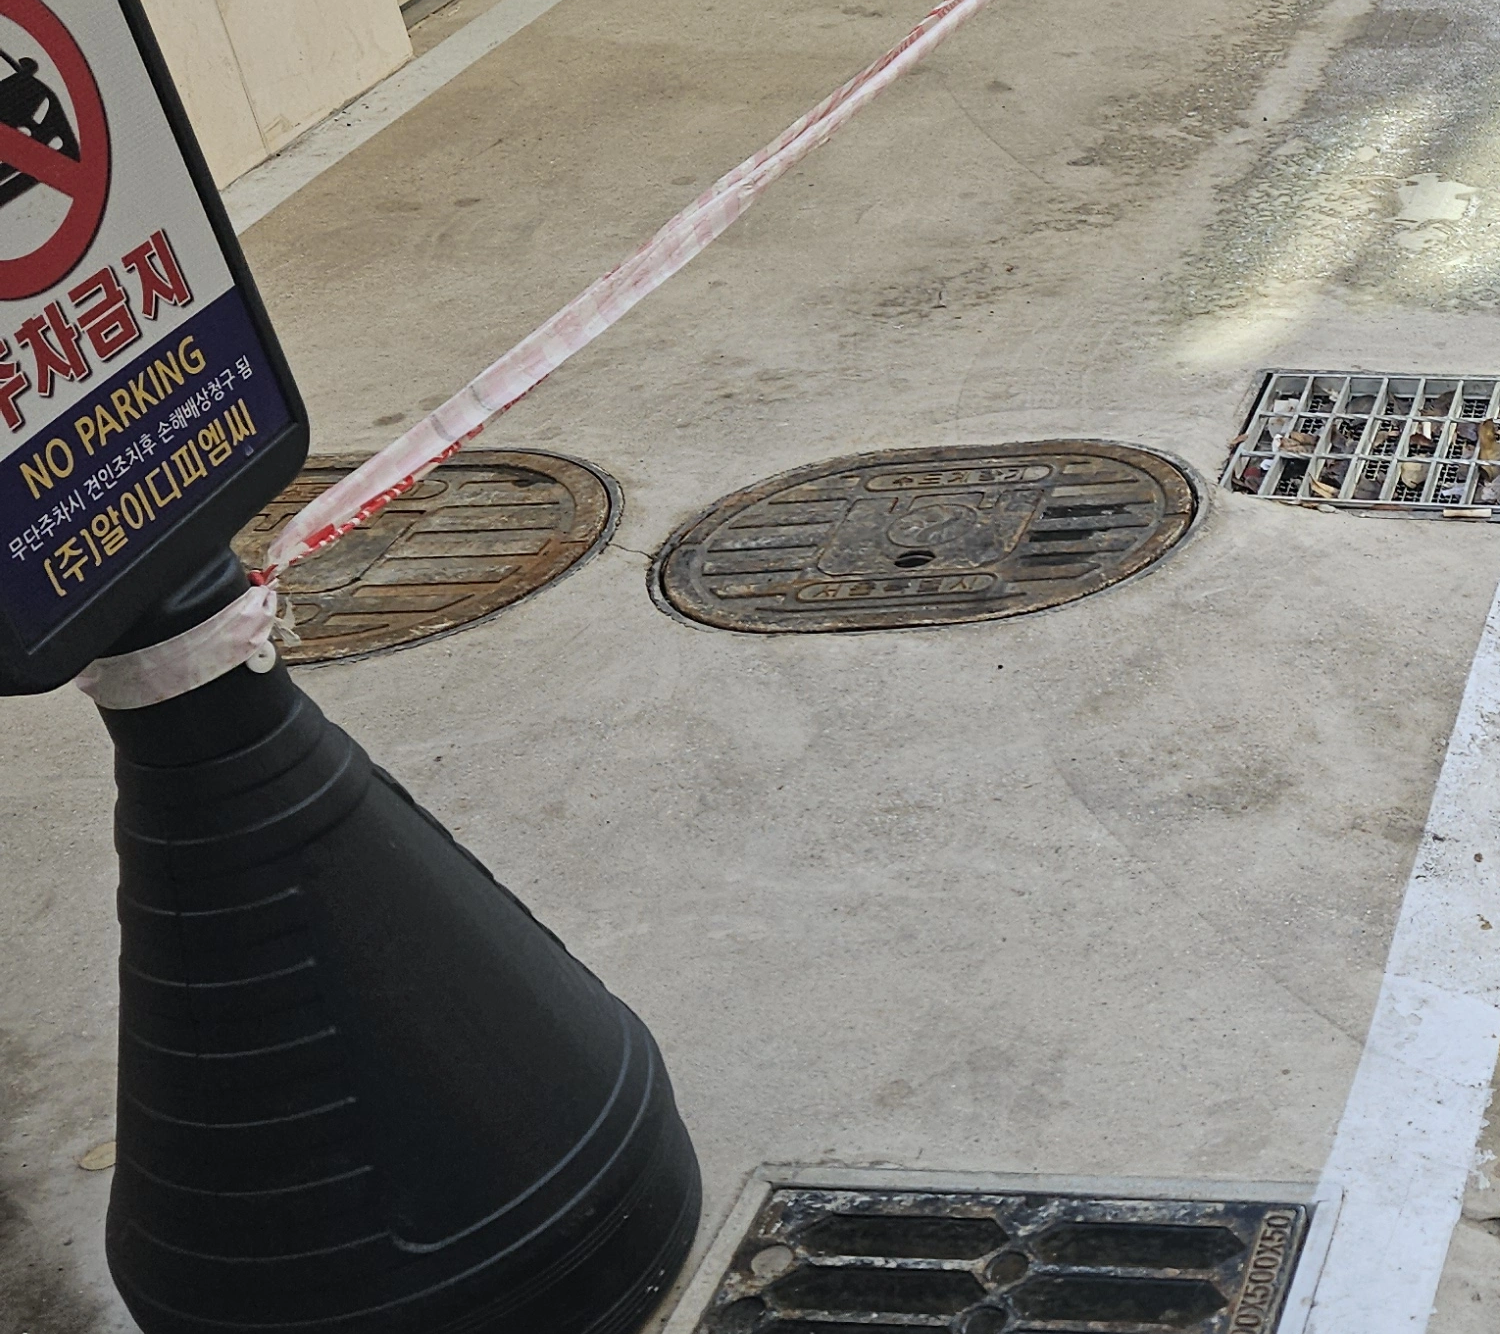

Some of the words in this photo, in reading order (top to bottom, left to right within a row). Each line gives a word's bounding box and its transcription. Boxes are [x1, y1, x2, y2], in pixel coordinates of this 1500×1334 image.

[8, 489, 86, 561] 무단주차시
[83, 433, 158, 501] 견인조치후
[156, 368, 236, 444] 손해배상청구
[235, 354, 253, 381] 됨
[19, 438, 75, 499] NO
[74, 335, 207, 456] PARKING
